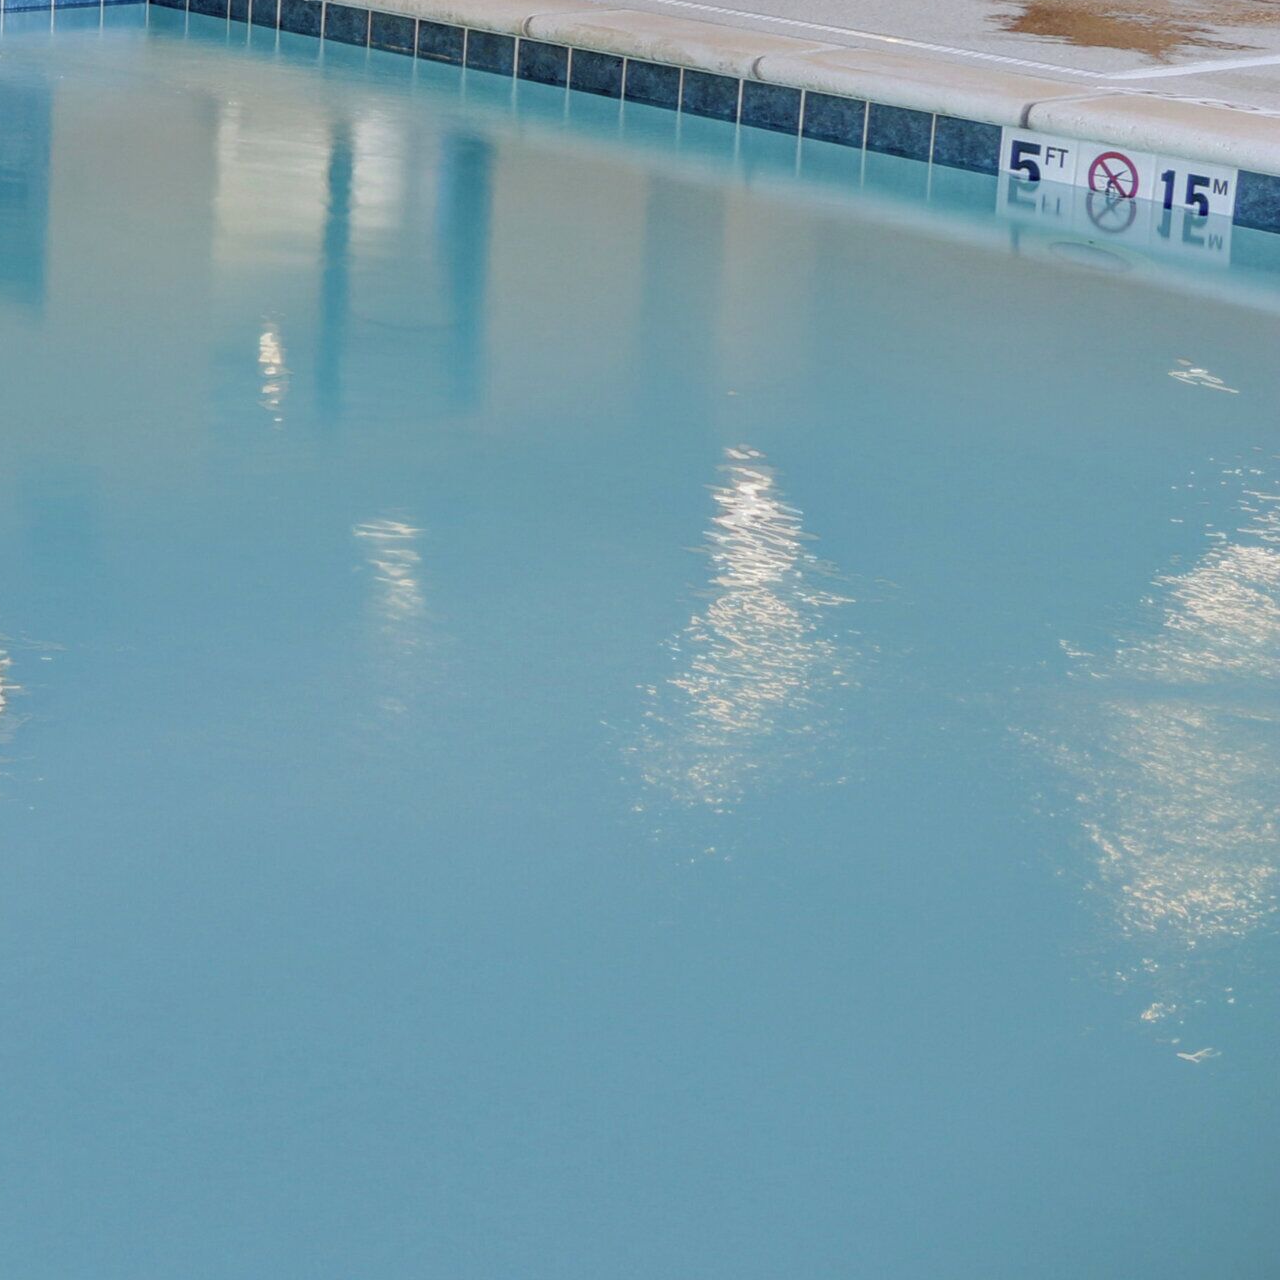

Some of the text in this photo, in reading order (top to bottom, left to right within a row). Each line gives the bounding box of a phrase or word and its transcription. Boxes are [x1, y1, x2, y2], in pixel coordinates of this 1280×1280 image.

[1010, 140, 1229, 217] 5 FT 15 M
